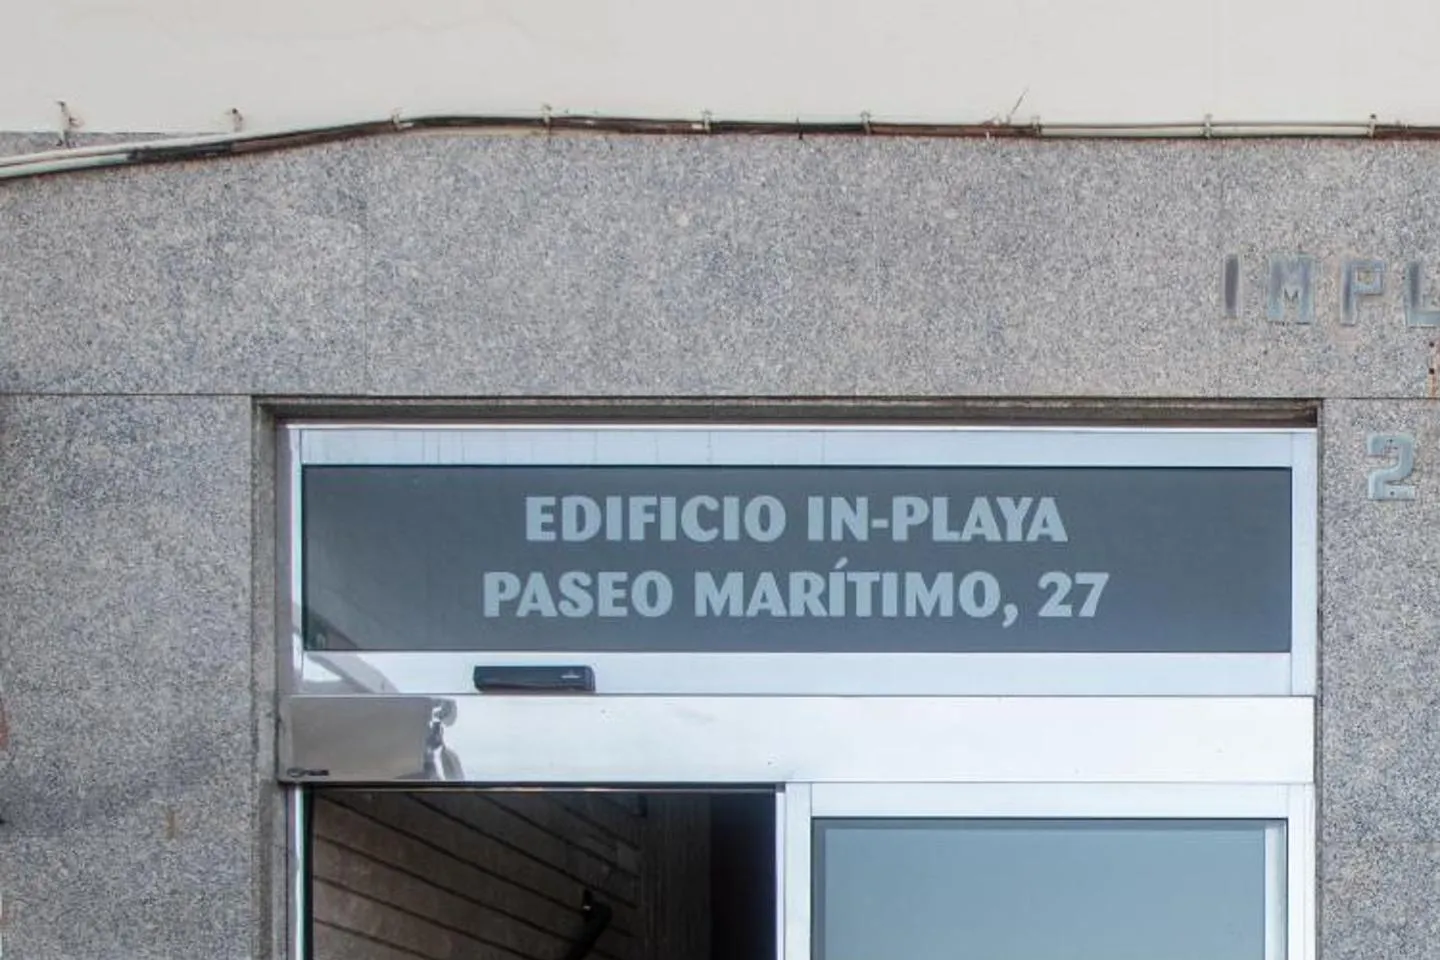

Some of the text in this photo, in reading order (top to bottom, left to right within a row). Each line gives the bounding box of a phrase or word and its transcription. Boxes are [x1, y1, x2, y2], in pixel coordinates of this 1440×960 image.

[525, 495, 1069, 543] EDIFICIO IN-PLAYA
[483, 557, 1110, 629] PASEO MARÍTIMO, 27
